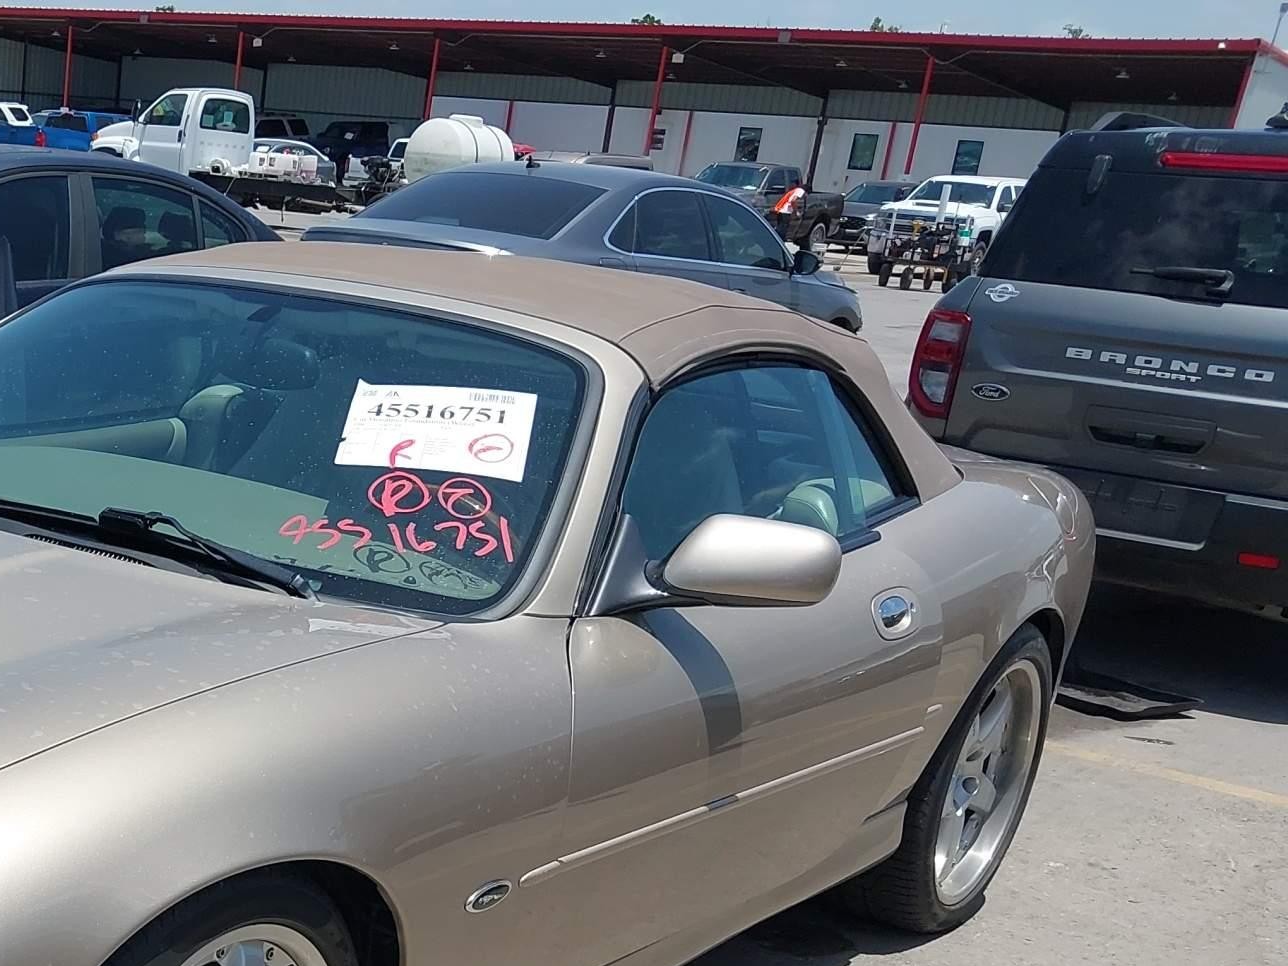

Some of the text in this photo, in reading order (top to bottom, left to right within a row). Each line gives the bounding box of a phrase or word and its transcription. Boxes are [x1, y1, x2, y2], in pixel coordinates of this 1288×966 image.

[1065, 347, 1275, 382] BRONCO
[1125, 367, 1202, 383] SPORT
[367, 402, 506, 424] 45516751
